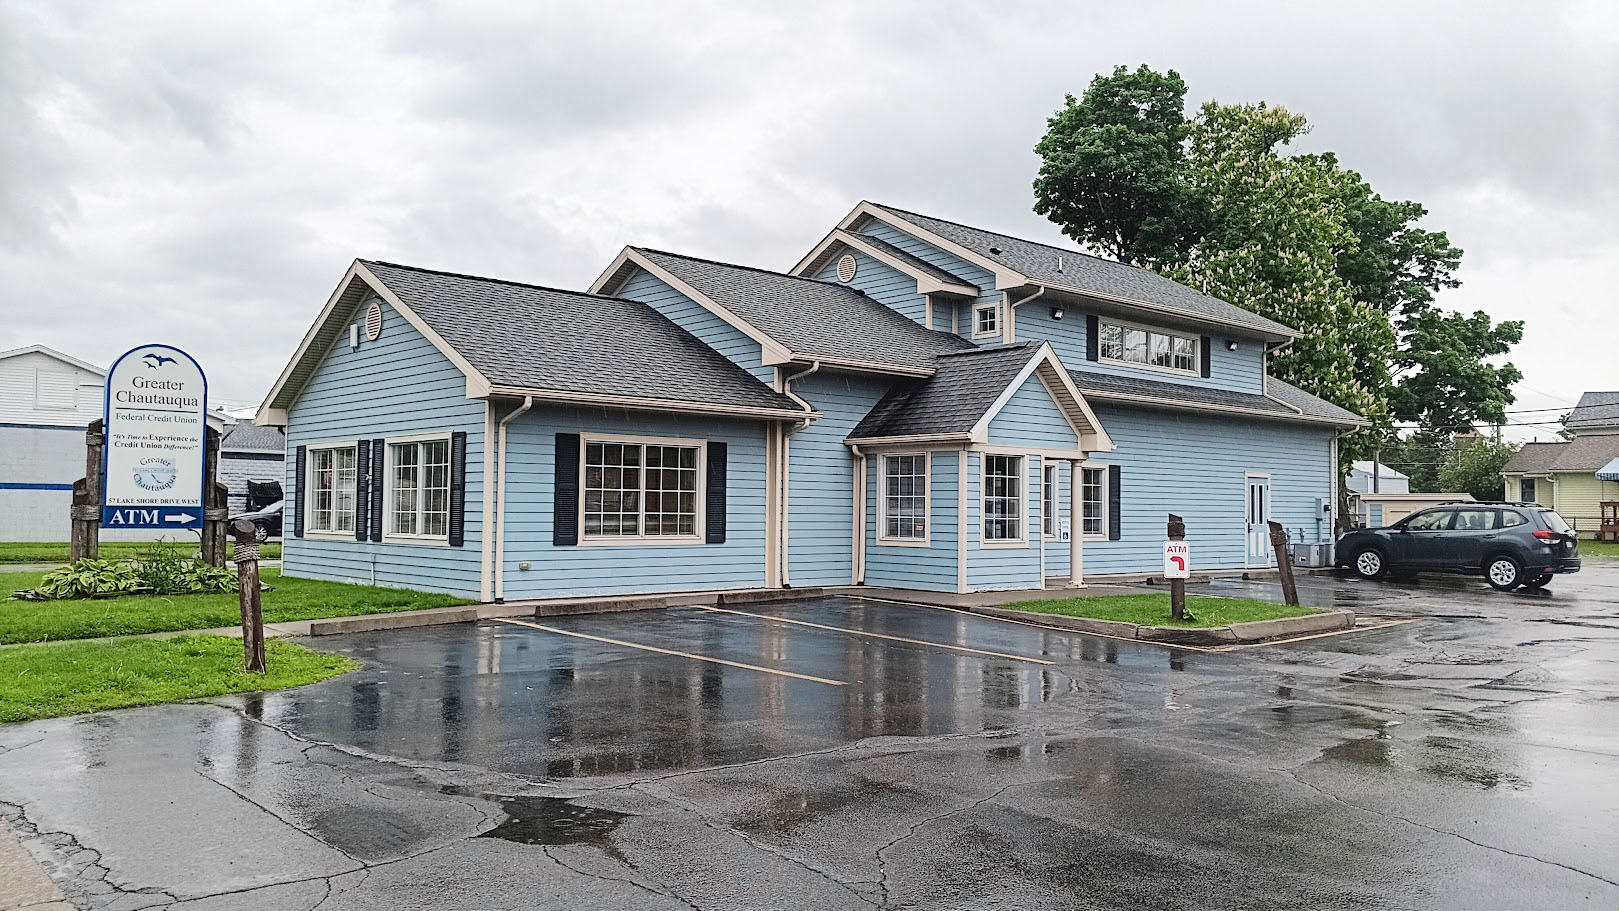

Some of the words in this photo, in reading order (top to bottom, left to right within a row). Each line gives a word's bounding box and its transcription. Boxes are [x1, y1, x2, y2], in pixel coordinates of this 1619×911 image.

[132, 376, 185, 391] Greater
[116, 390, 198, 408] Chautauqua
[115, 412, 145, 421] Federal
[147, 414, 172, 423] Credit
[174, 415, 198, 424] Union
[149, 433, 189, 442] Experience
[114, 440, 138, 448] Credit
[140, 441, 163, 449] Union
[139, 457, 172, 467] Greater
[133, 473, 177, 492] Chautauqua
[109, 509, 160, 525] ATM
[1167, 545, 1187, 553] ATM
